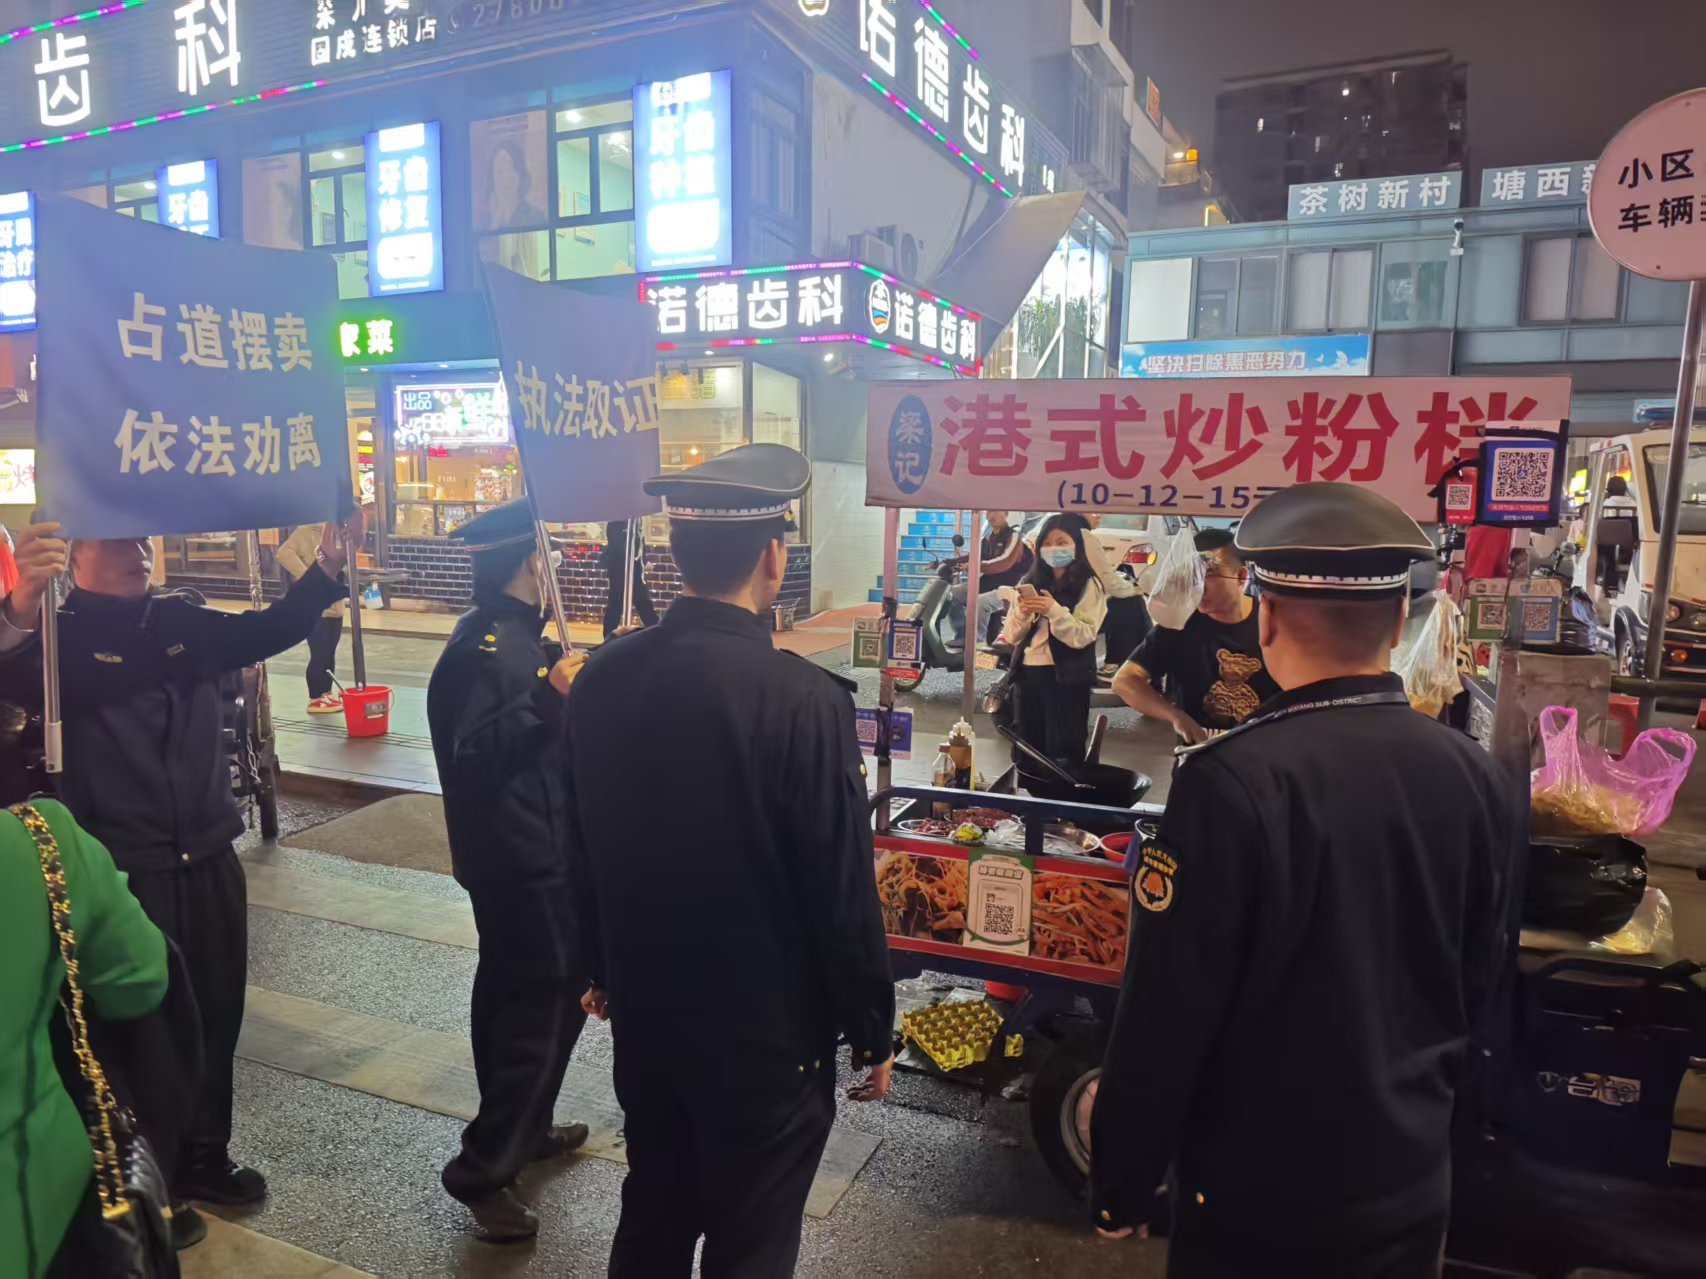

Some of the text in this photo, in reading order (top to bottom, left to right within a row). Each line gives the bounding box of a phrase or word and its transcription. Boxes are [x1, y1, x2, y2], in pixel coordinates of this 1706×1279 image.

[34, 0, 241, 127] 齿科
[1300, 176, 1454, 217] 茶树新村
[1618, 148, 1694, 188] 小区
[1618, 195, 1706, 232] 车辆
[117, 292, 313, 372] 占道摆卖
[647, 274, 843, 335] 诺德齿科
[895, 290, 977, 362] 诺德齿科
[1147, 350, 1306, 374] 坚决扫除黑恶势力
[514, 360, 659, 439] 执法取证
[114, 408, 321, 477] 依法劝离
[940, 391, 1539, 484] 港式炒粉档
